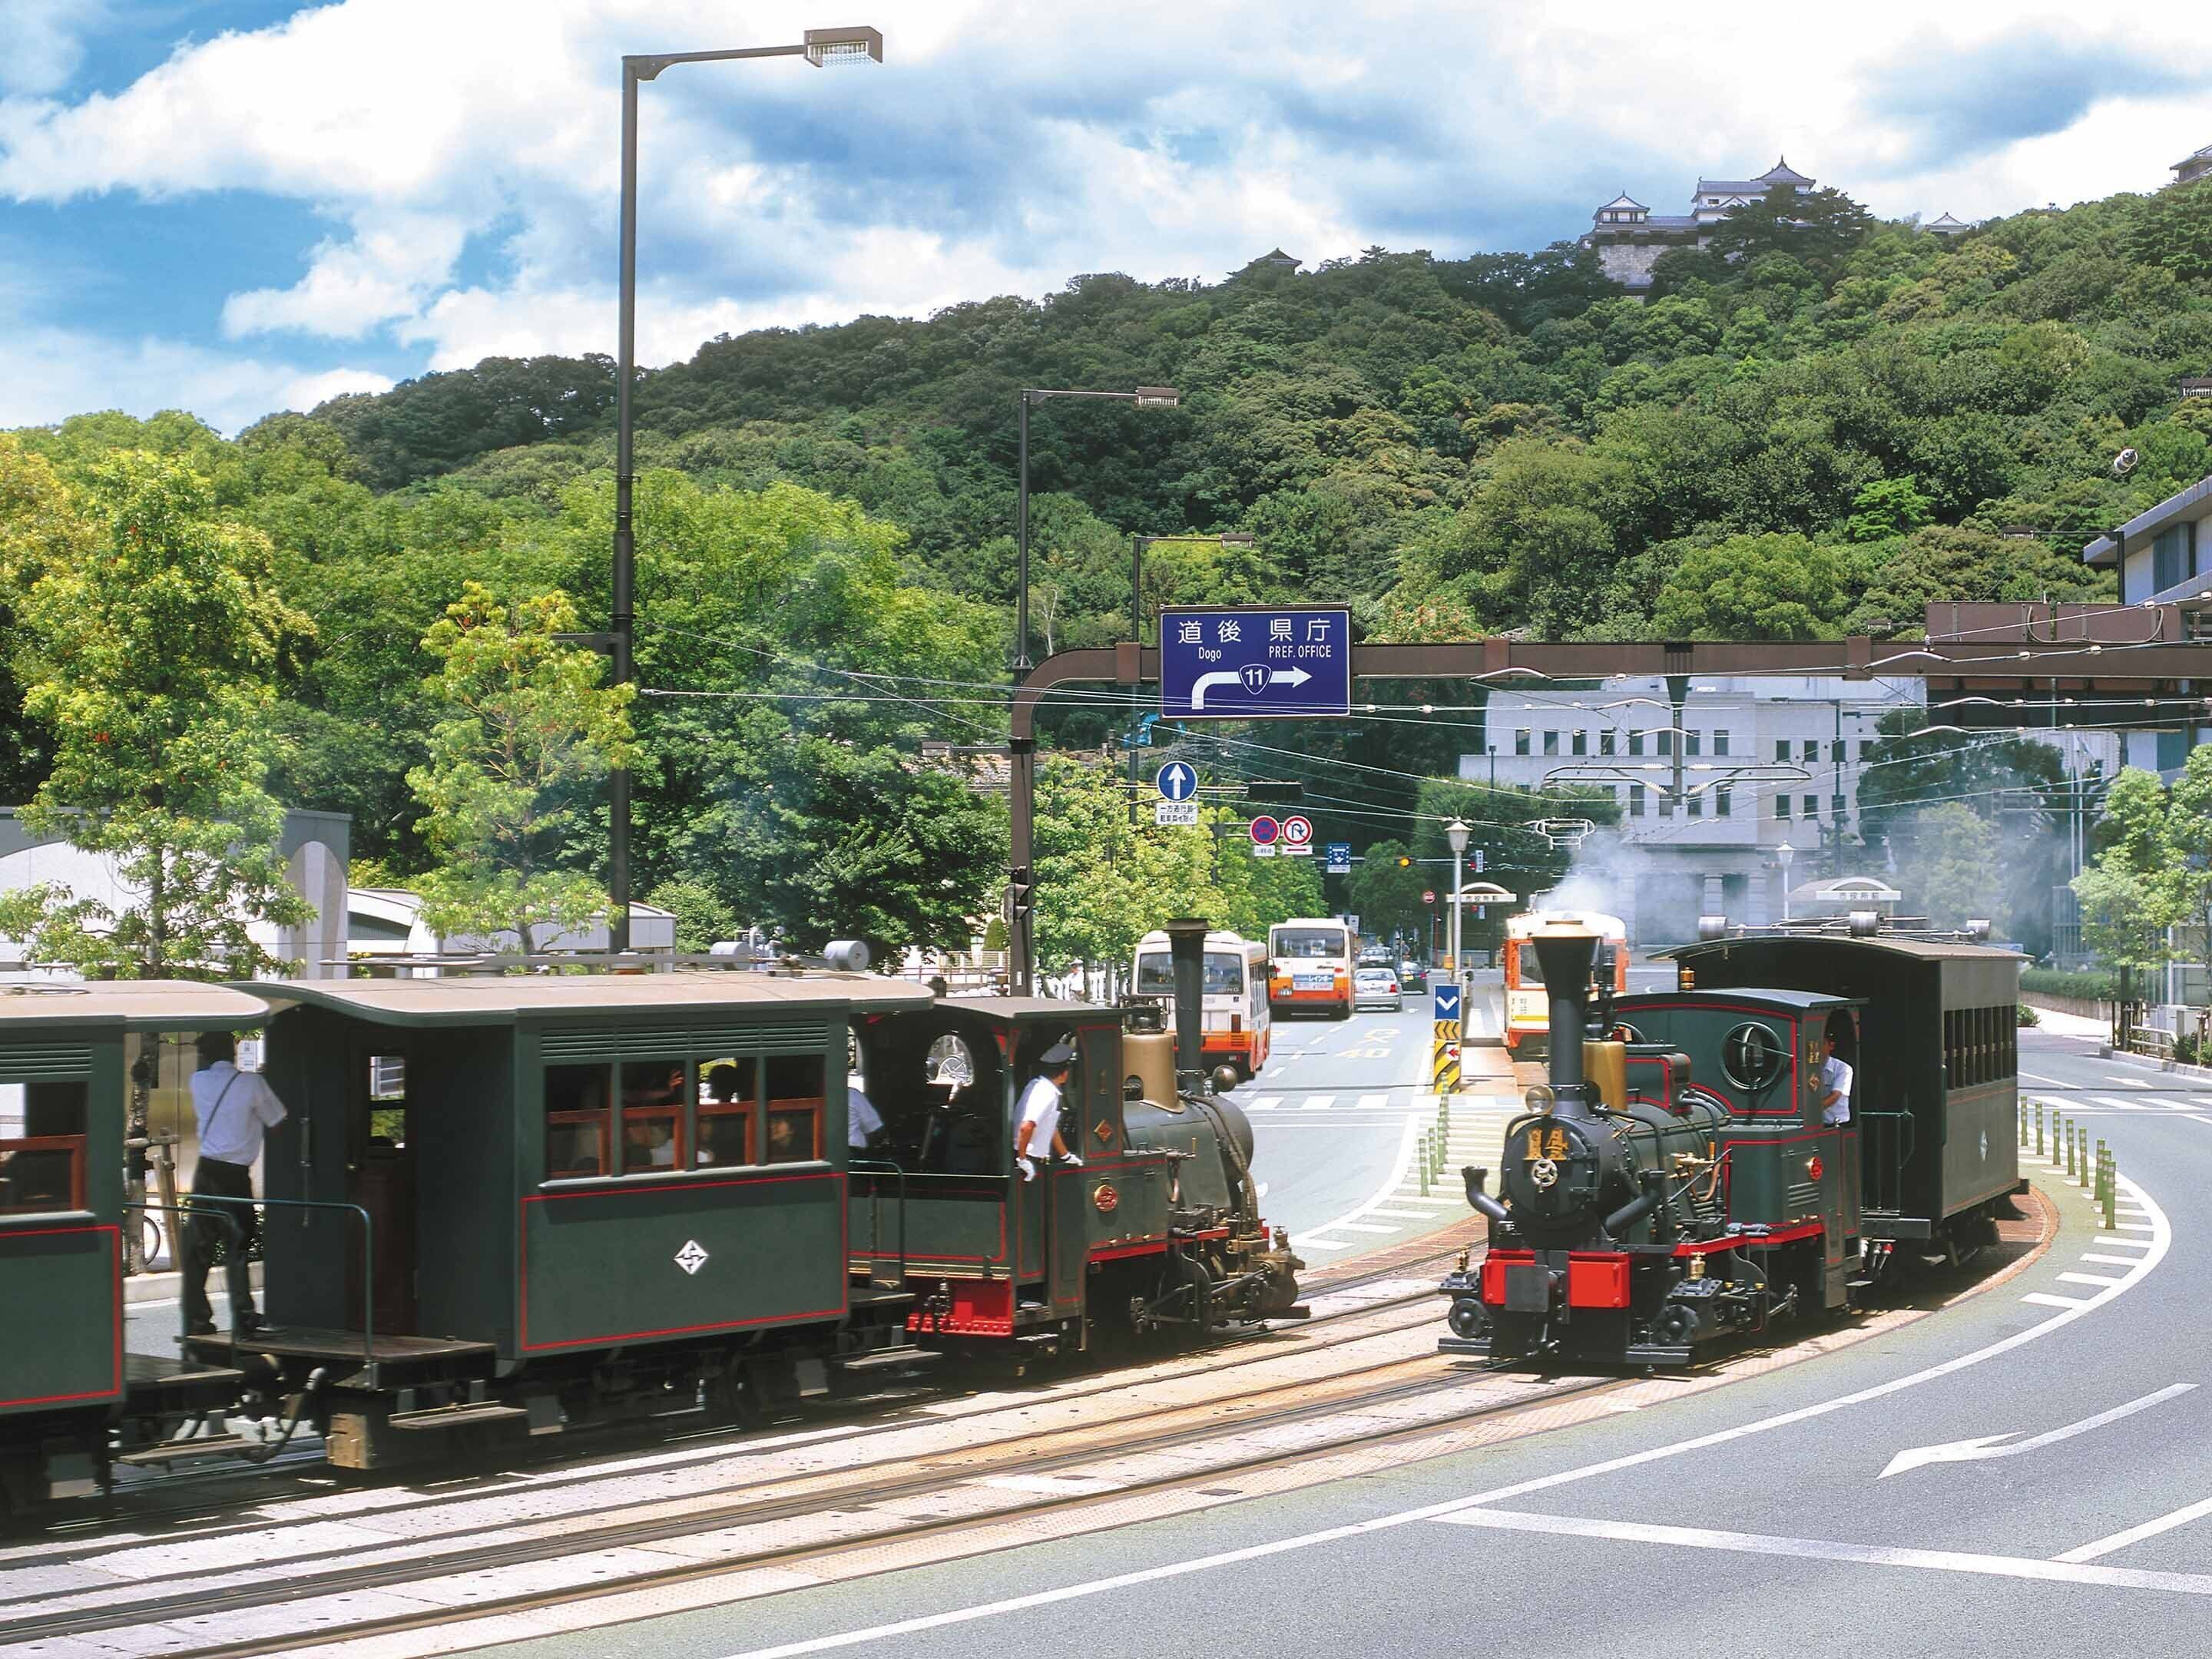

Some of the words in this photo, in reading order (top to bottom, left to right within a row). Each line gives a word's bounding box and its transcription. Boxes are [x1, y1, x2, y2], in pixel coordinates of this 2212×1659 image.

[1177, 619, 1242, 644] 道後
[1269, 618, 1332, 642] 県庁
[1198, 647, 1222, 663] Dogo
[1269, 645, 1296, 658] PREF.
[1298, 644, 1332, 658] OFFICE
[1245, 669, 1264, 686] 11
[1524, 1126, 1568, 1161] 14
